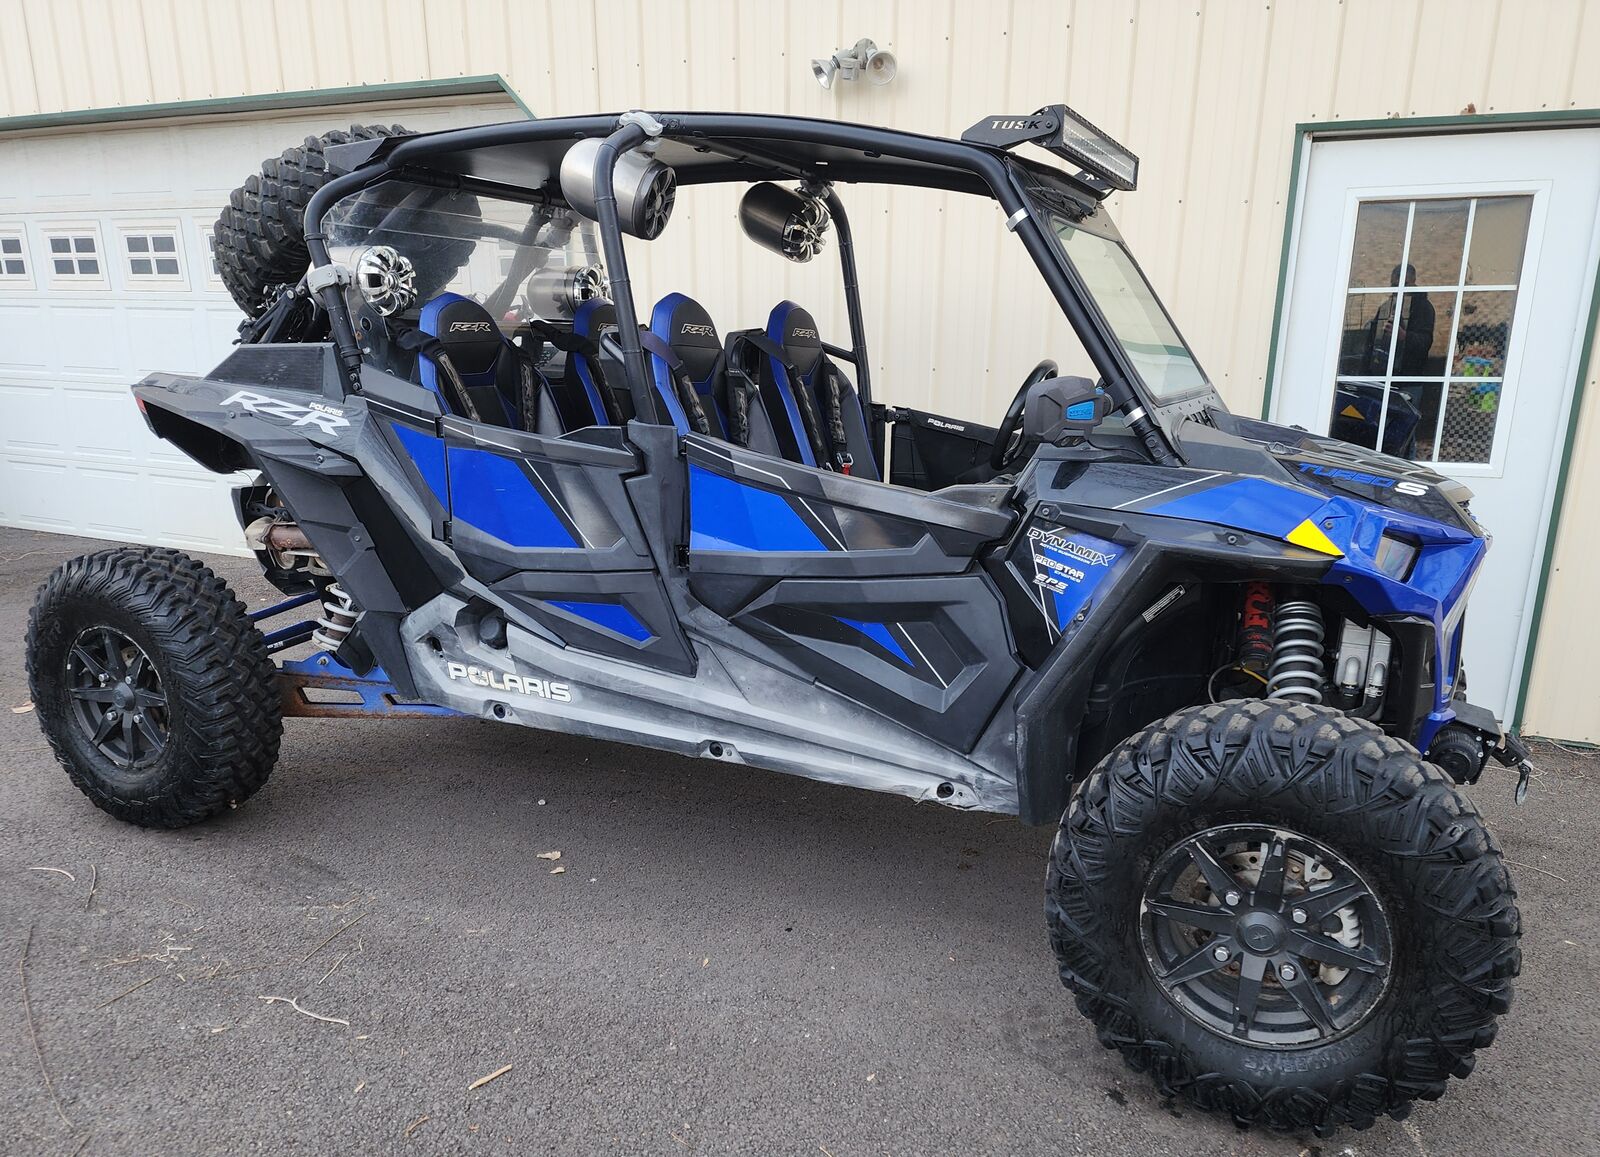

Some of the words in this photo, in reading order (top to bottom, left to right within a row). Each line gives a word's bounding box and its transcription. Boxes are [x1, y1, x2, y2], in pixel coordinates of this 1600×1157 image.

[991, 120, 1043, 130] TUSK
[450, 322, 492, 332] RZR
[681, 323, 714, 337] RZR
[792, 327, 817, 339] RZR
[219, 390, 350, 437] RZR
[309, 402, 344, 417] POLARIS
[927, 418, 965, 432] POLARIS
[1299, 463, 1398, 488] TURBO
[1394, 482, 1429, 496] S
[1027, 527, 1117, 567] DYNAMIX
[1034, 553, 1085, 580] PROSTAR
[1035, 573, 1069, 590] EPS
[447, 661, 572, 703] POLARIS
